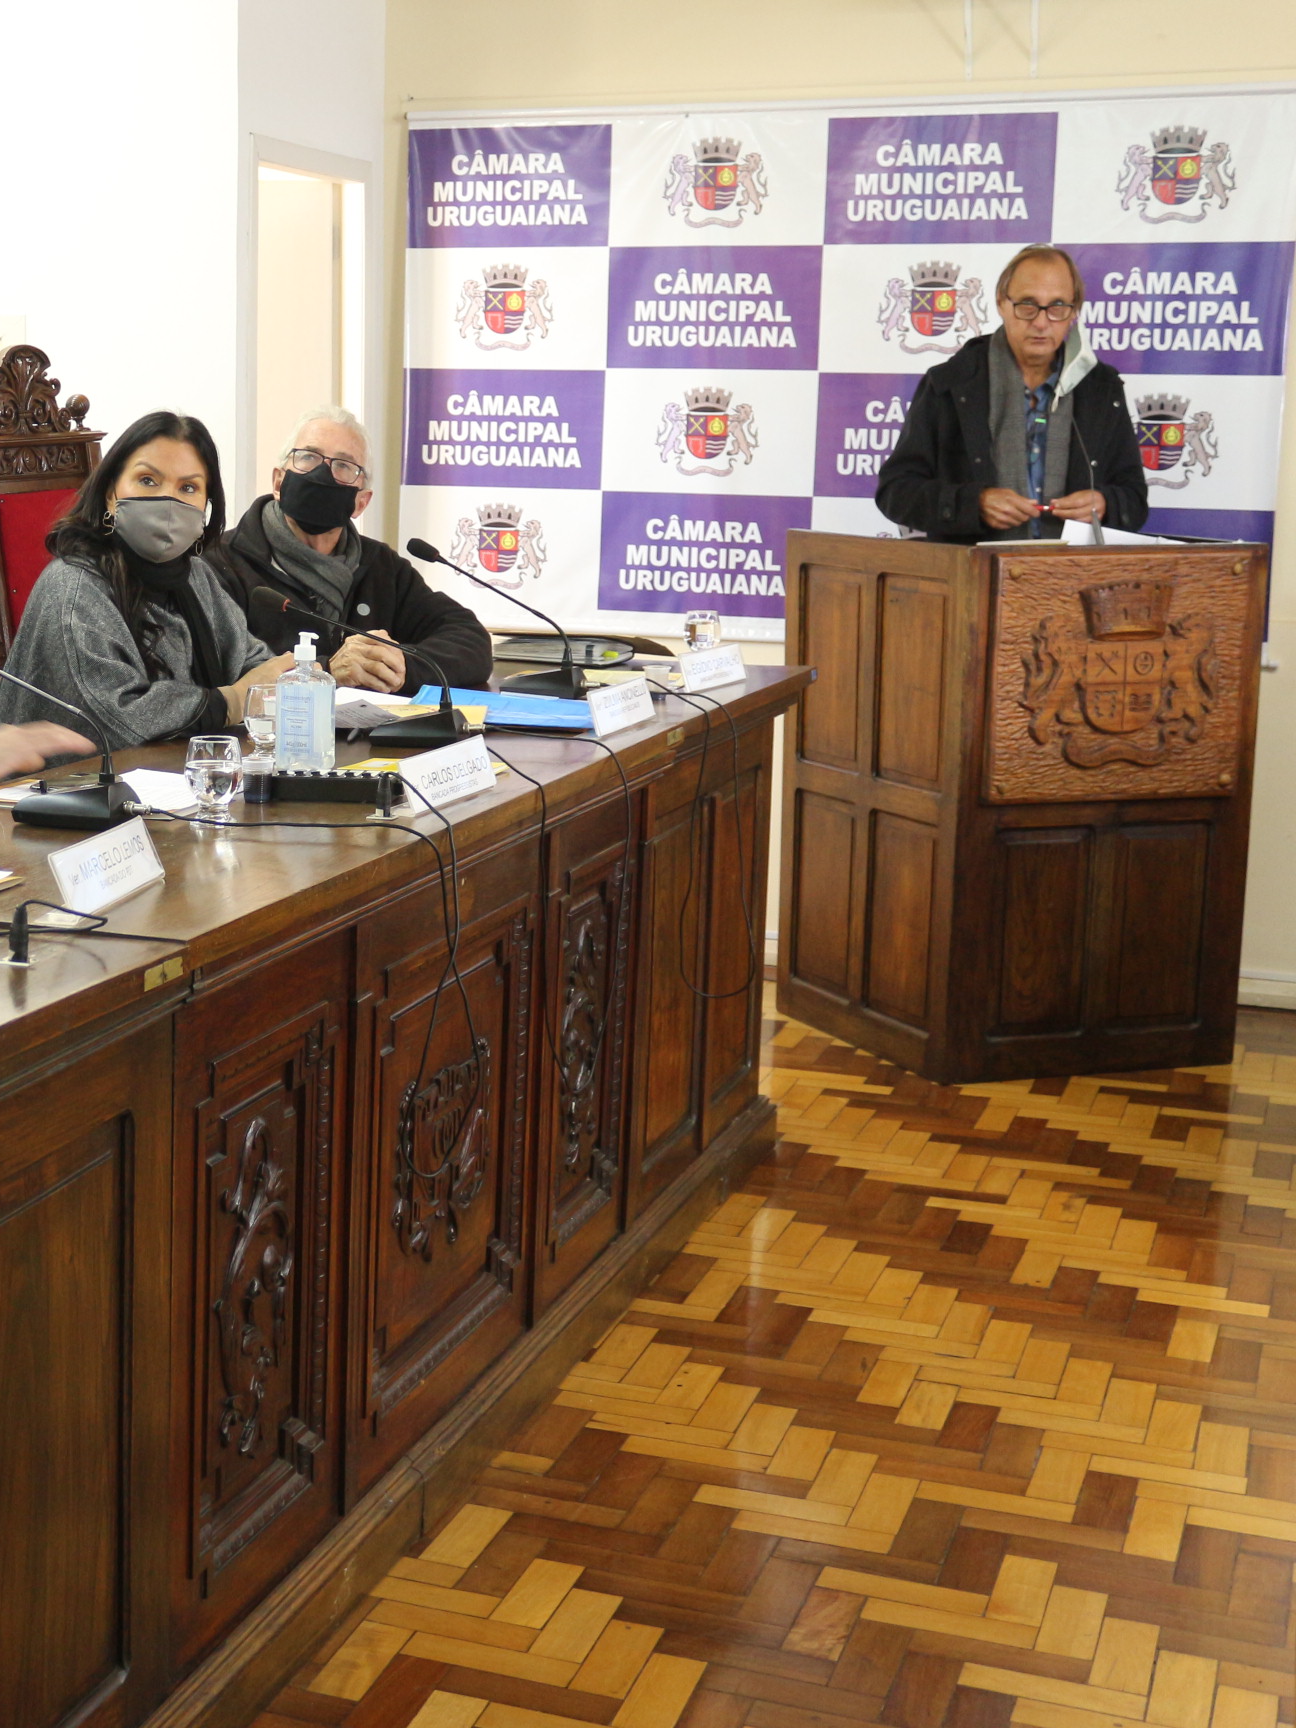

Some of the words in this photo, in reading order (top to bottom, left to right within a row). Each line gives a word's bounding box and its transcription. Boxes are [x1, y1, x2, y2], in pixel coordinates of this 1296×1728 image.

[451, 149, 565, 176] CÂMARA
[876, 139, 1003, 167] CÂMARA
[433, 179, 583, 203] MUNICIPAL
[854, 171, 1023, 196] MUNICIPAL
[427, 204, 588, 227] URUGUAIANA
[847, 197, 1029, 222] URUGUAIANA
[654, 269, 773, 295] CÂMARA
[1103, 267, 1239, 295] CÂMARA
[634, 299, 792, 323] MUNICIPAL
[1080, 300, 1259, 325] MUNICIPAL
[627, 324, 797, 349] URUGUAIANA
[1088, 328, 1264, 352] RUGUAIANA
[446, 390, 559, 417] CÂMARA
[428, 421, 577, 444] MUNICIPAL
[421, 444, 582, 468] URUGUAIANA
[646, 514, 763, 544] CÂMARA
[626, 545, 782, 572] MUNICIPAL
[618, 569, 786, 597] URUGUAIANA
[420, 766, 454, 790] CARLOS
[453, 755, 488, 779] DELGADO
[79, 847, 122, 880] MARCELO
[121, 834, 145, 861] LEMOS
